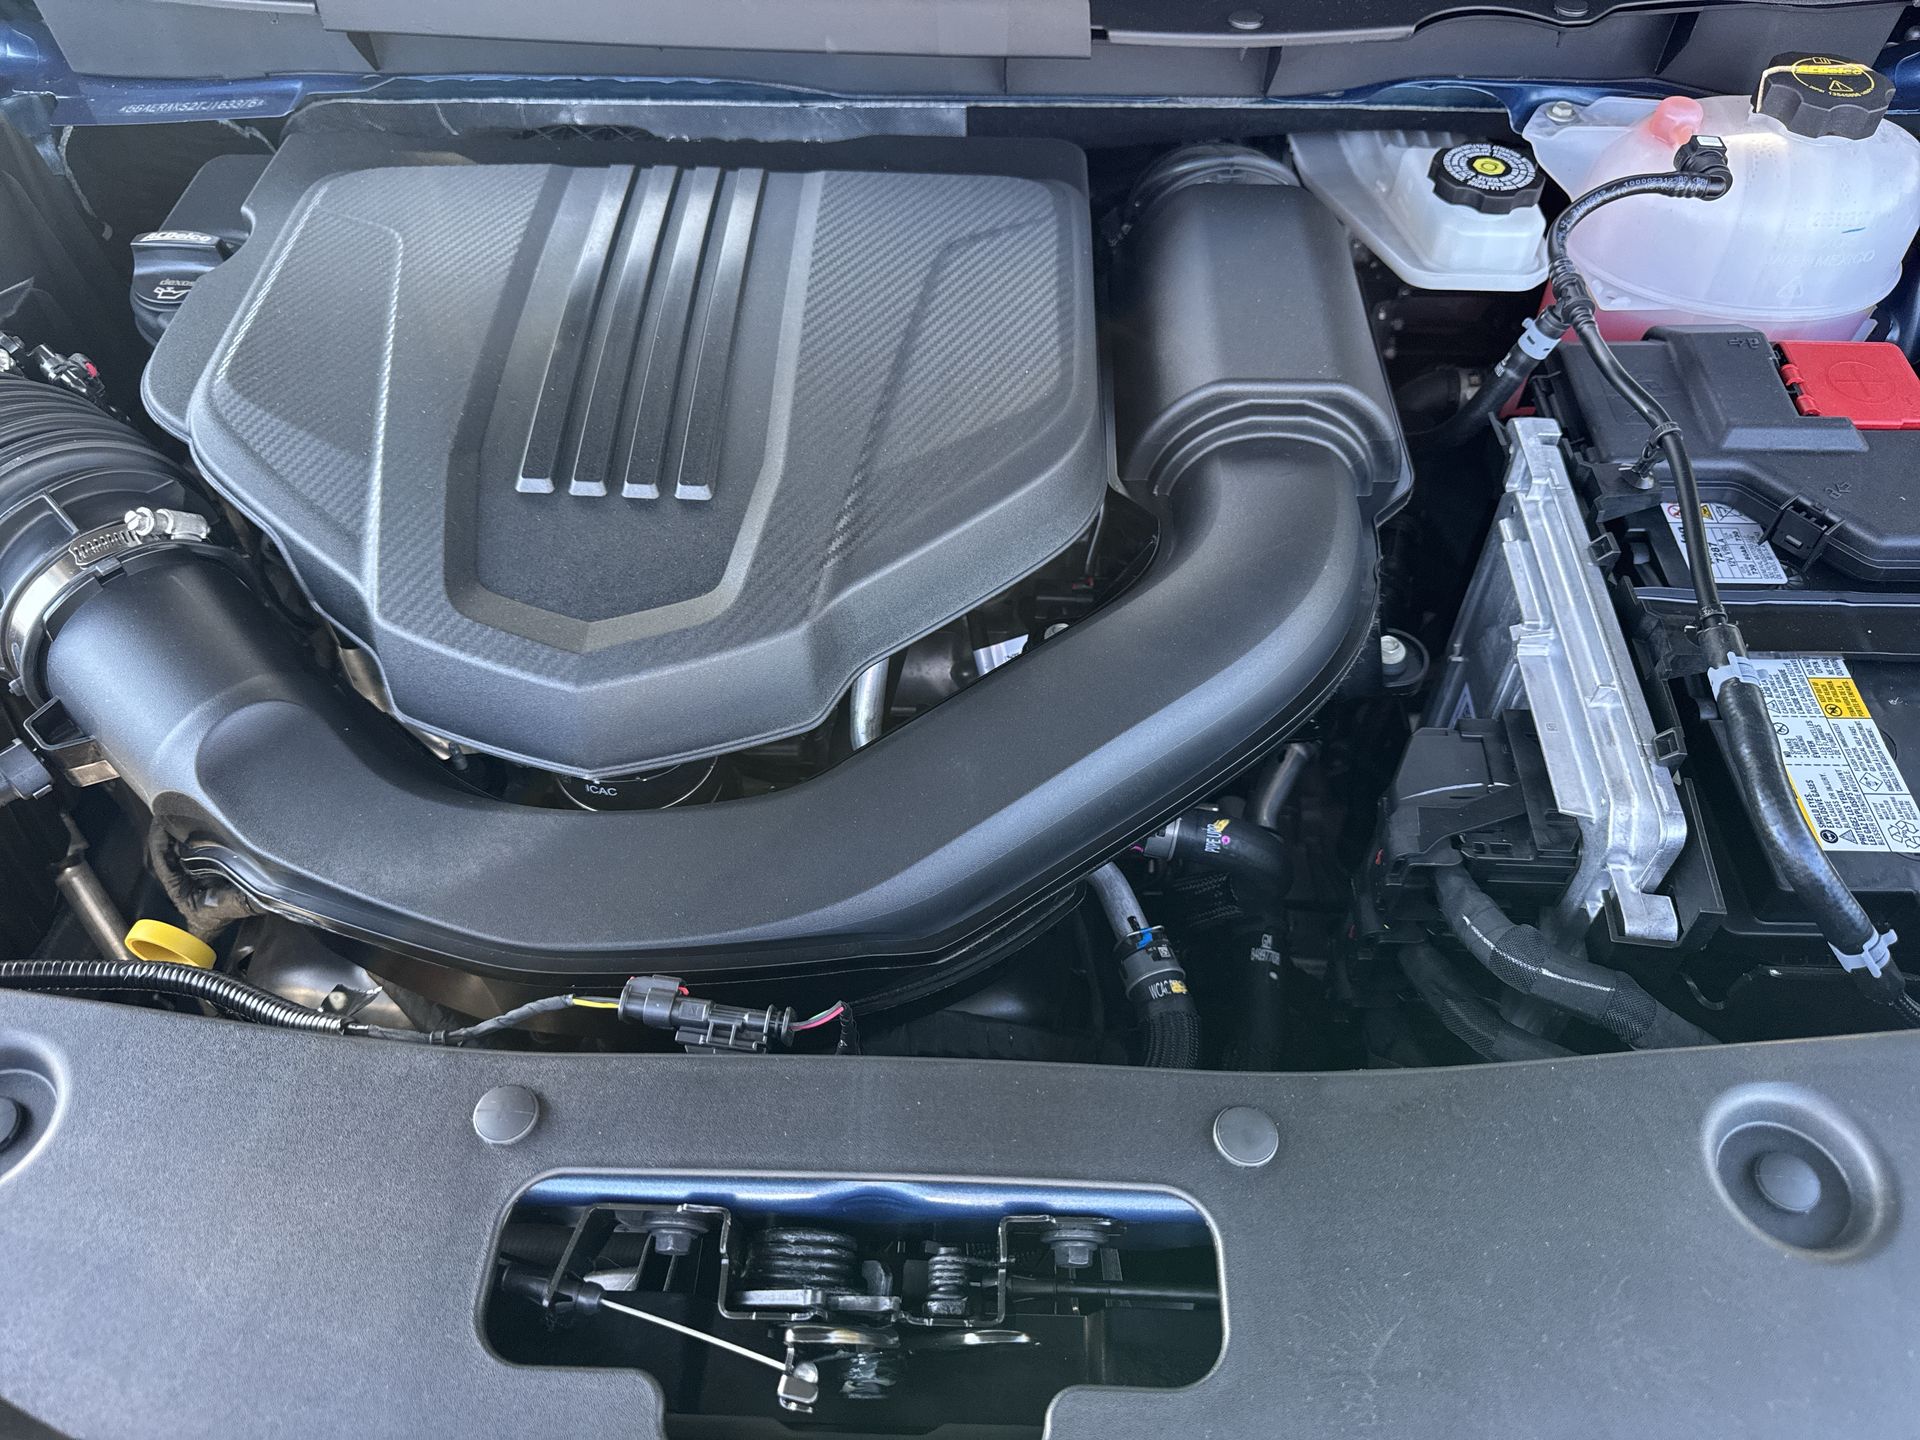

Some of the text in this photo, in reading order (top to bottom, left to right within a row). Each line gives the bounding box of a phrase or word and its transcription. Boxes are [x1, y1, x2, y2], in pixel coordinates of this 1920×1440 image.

[139, 231, 212, 242] ACDelco
[1707, 542, 1725, 563] 7287
[1811, 661, 1823, 673] OPEN
[1780, 690, 1792, 706] SEVERE
[1793, 684, 1807, 701] CAUSER
[1817, 694, 1826, 702] KEEP
[1777, 699, 1789, 713] CAUSE
[1802, 703, 1814, 713] PEUT
[1824, 732, 1837, 748] FUMER
[1853, 736, 1863, 746] HELP
[1817, 746, 1827, 755] LES
[1824, 746, 1834, 755] LES
[1844, 748, 1853, 757] EYES
[1858, 747, 1871, 763] MEDICAL
[1849, 758, 1860, 771] FLUSH
[1857, 761, 1868, 771] WITH
[585, 784, 618, 796] ICAC
[1805, 779, 1834, 828] EXPLOSIVE GASES
[1834, 769, 1877, 845] LES GAZ EXPLOSIFS PEUVENT
[1854, 793, 1869, 812] RENDRE
[1823, 800, 1842, 828] CAN CAUSE
[1831, 800, 1851, 828] BLINDNESS
[1842, 805, 1854, 815] LES
[1810, 809, 1826, 827] SHIELD
[1868, 822, 1884, 845] BLESSER
